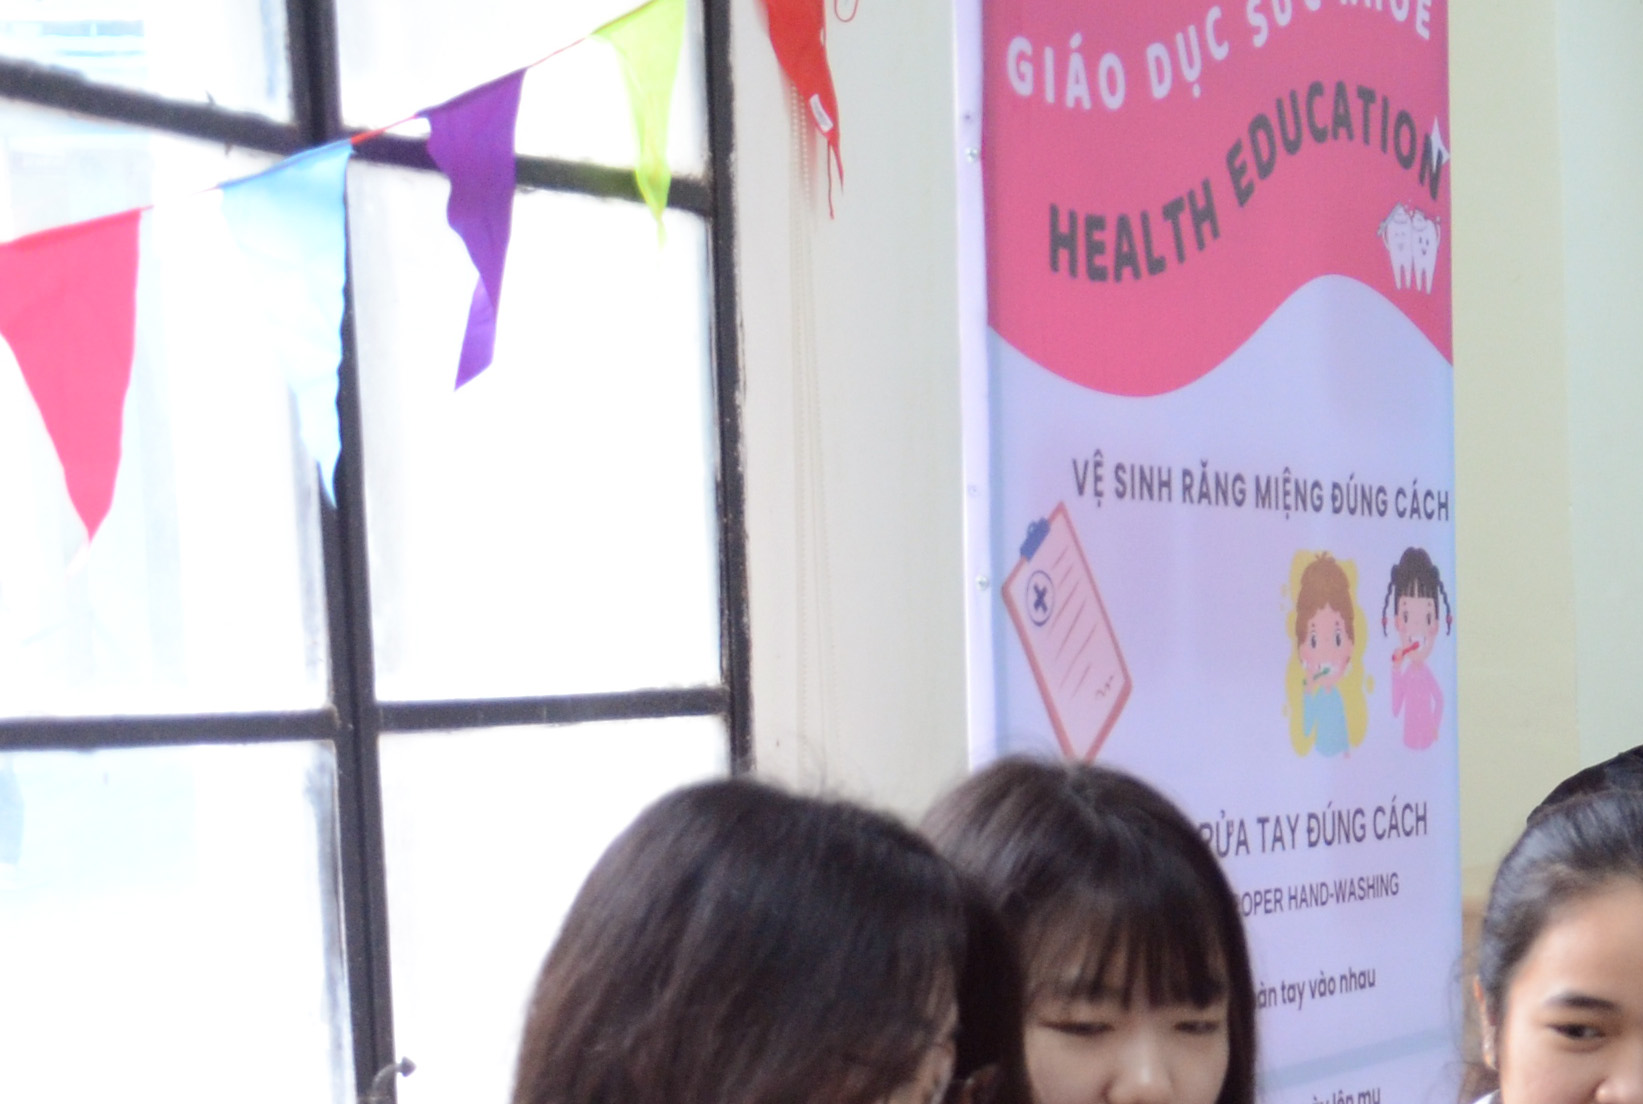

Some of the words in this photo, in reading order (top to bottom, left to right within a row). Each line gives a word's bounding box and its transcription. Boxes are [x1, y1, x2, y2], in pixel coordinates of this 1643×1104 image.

[1007, 32, 1126, 110] GIÁO
[1146, 6, 1229, 99] DỤC
[1049, 178, 1221, 283] HEALTH
[1226, 81, 1443, 207] EDUCATION
[1073, 449, 1104, 508] VỆ
[1115, 462, 1172, 502] SINH
[1182, 459, 1247, 507] RĂNG
[1255, 467, 1324, 520] MIỆNG
[1331, 471, 1388, 518] ĐÚNG
[1395, 477, 1449, 521] CÁCH
[1257, 812, 1300, 854] TAY
[1306, 801, 1366, 848] ĐÚNG
[1373, 794, 1428, 842] CÁCH
[1241, 887, 1284, 917] OPER
[1288, 872, 1400, 911] HAND-WASHING
[1257, 981, 1277, 1009] àn
[1281, 980, 1305, 1011] tay
[1308, 970, 1336, 999] vào
[1340, 966, 1376, 994] nhau
